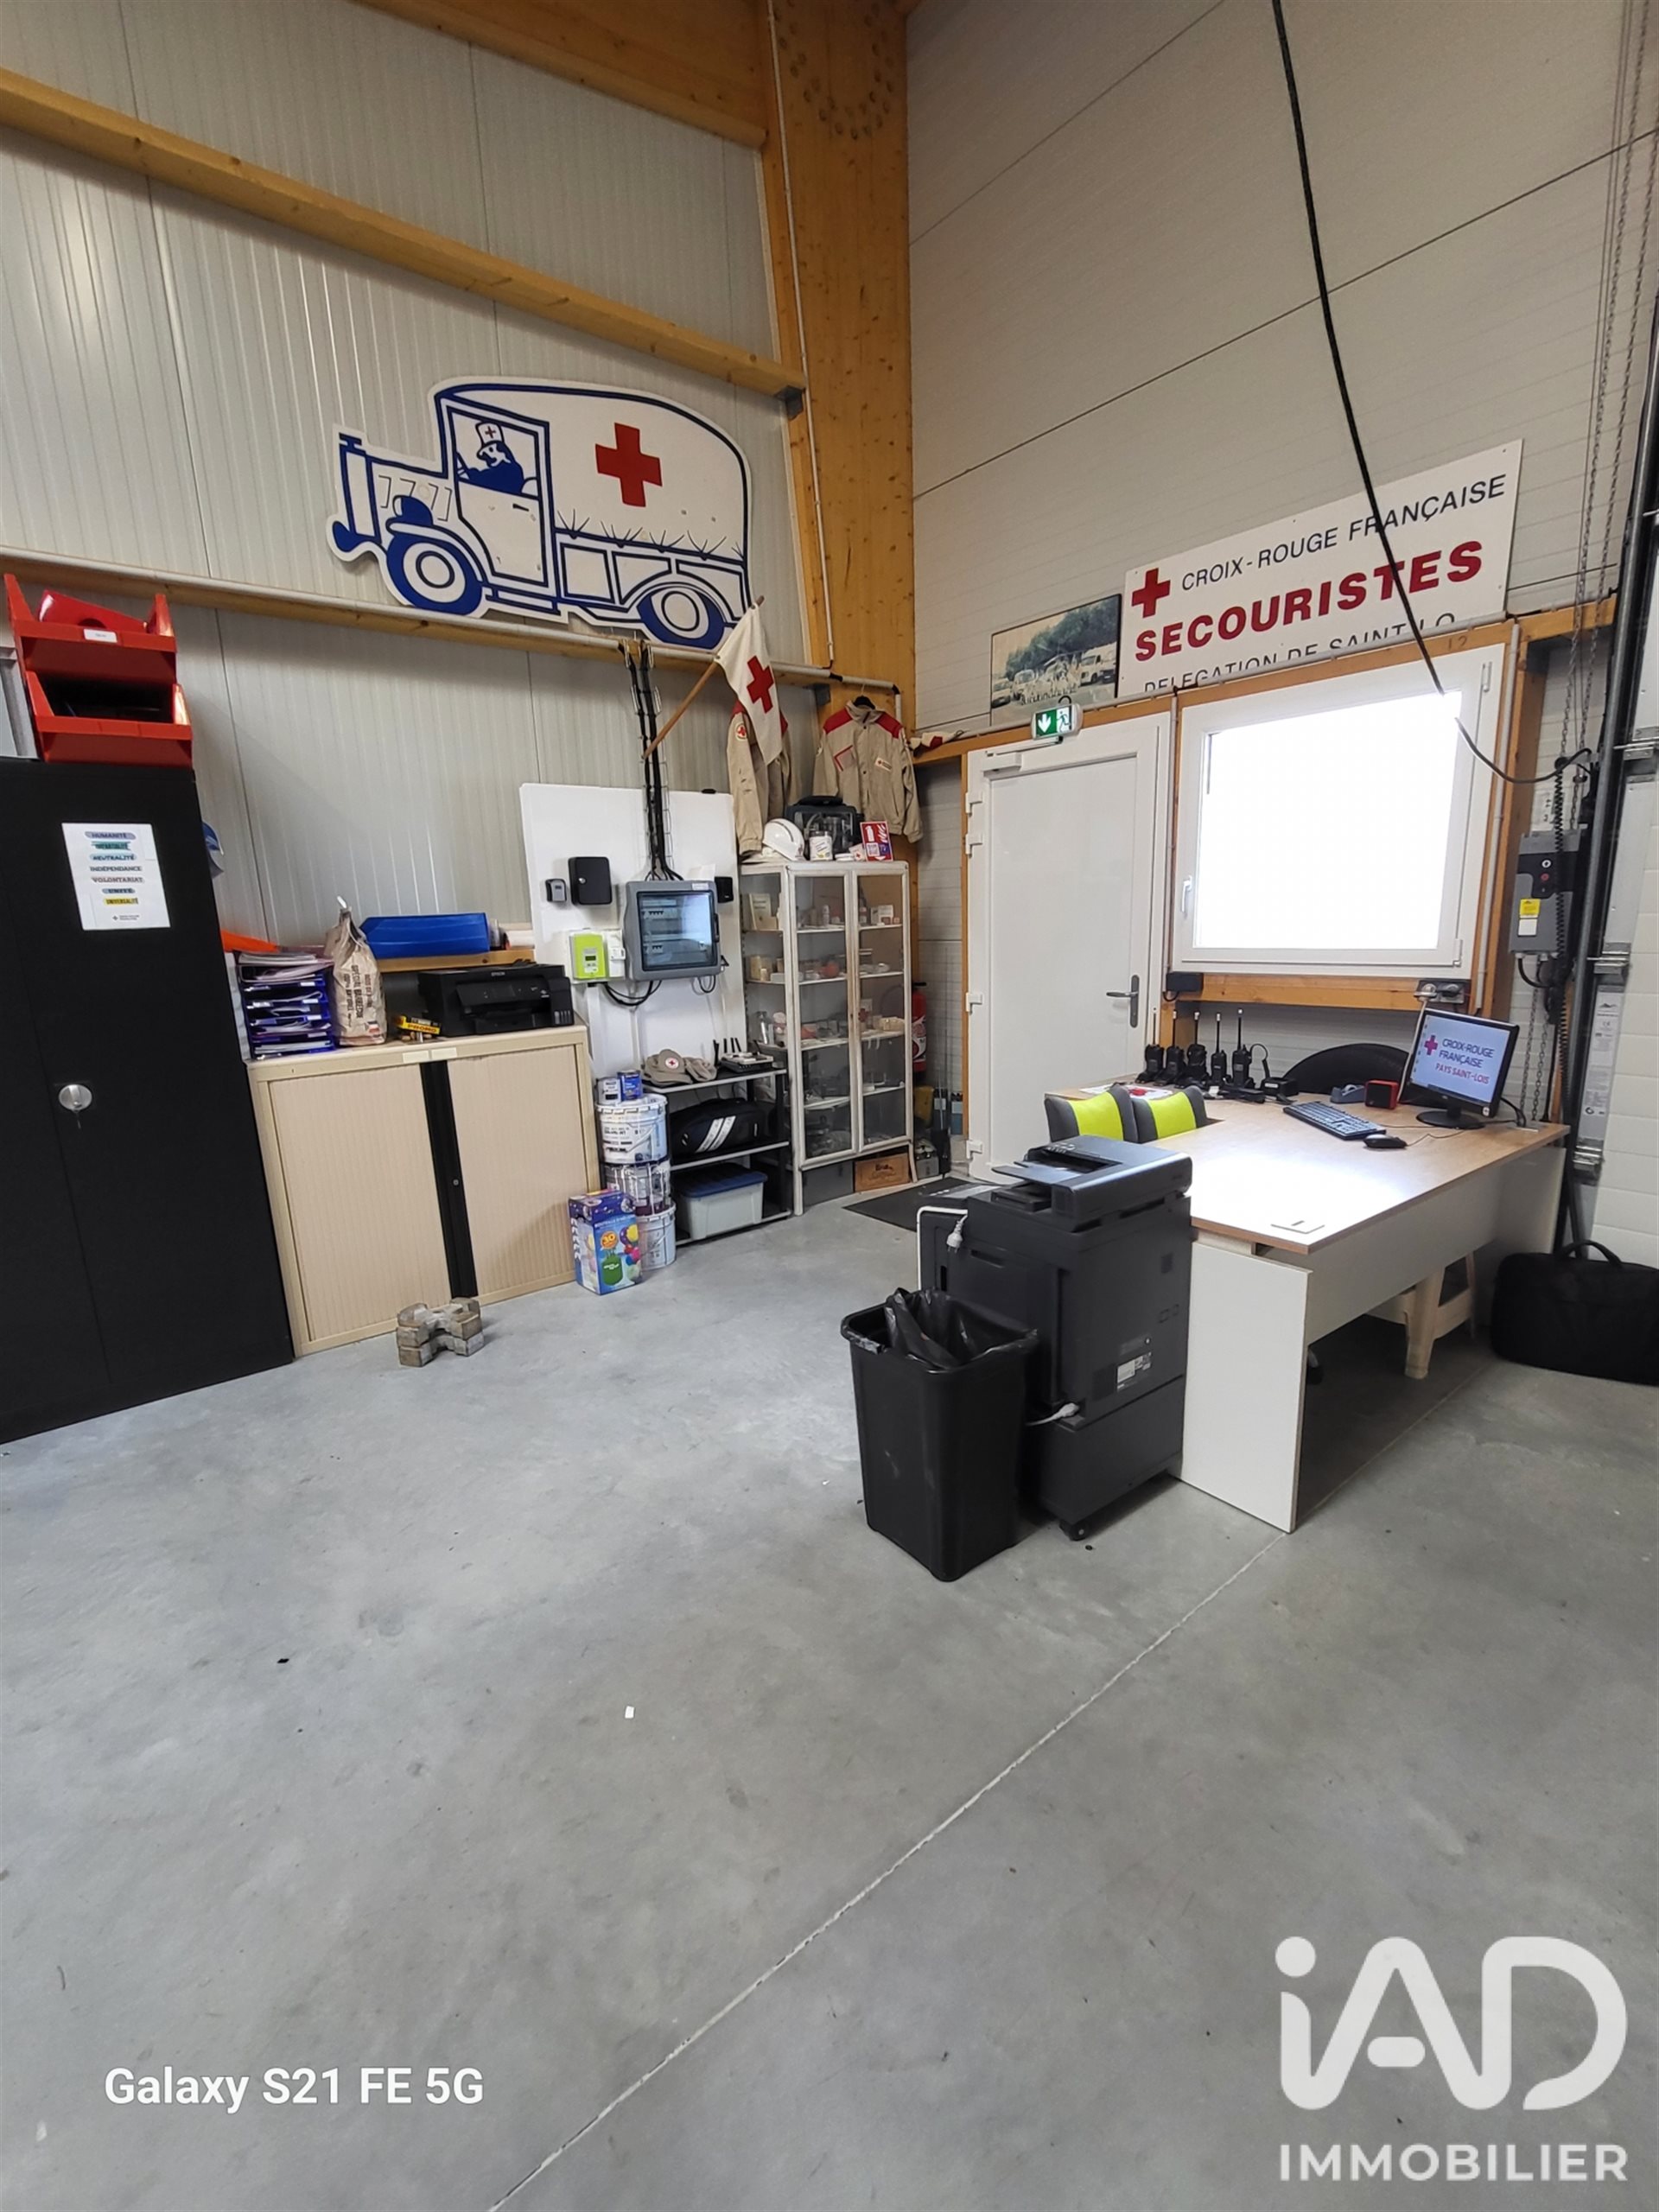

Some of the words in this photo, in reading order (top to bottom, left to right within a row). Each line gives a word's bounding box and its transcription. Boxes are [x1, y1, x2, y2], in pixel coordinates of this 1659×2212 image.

[1181, 527, 1338, 591] CROIX-ROUGE
[1348, 474, 1507, 543] FRANÇAISE
[1135, 540, 1484, 662] SECOURISTES
[1442, 1038, 1496, 1058] CROIX-ROUGE
[1434, 1062, 1452, 1075] PAYS
[1438, 1049, 1484, 1069] FRANÇAISE
